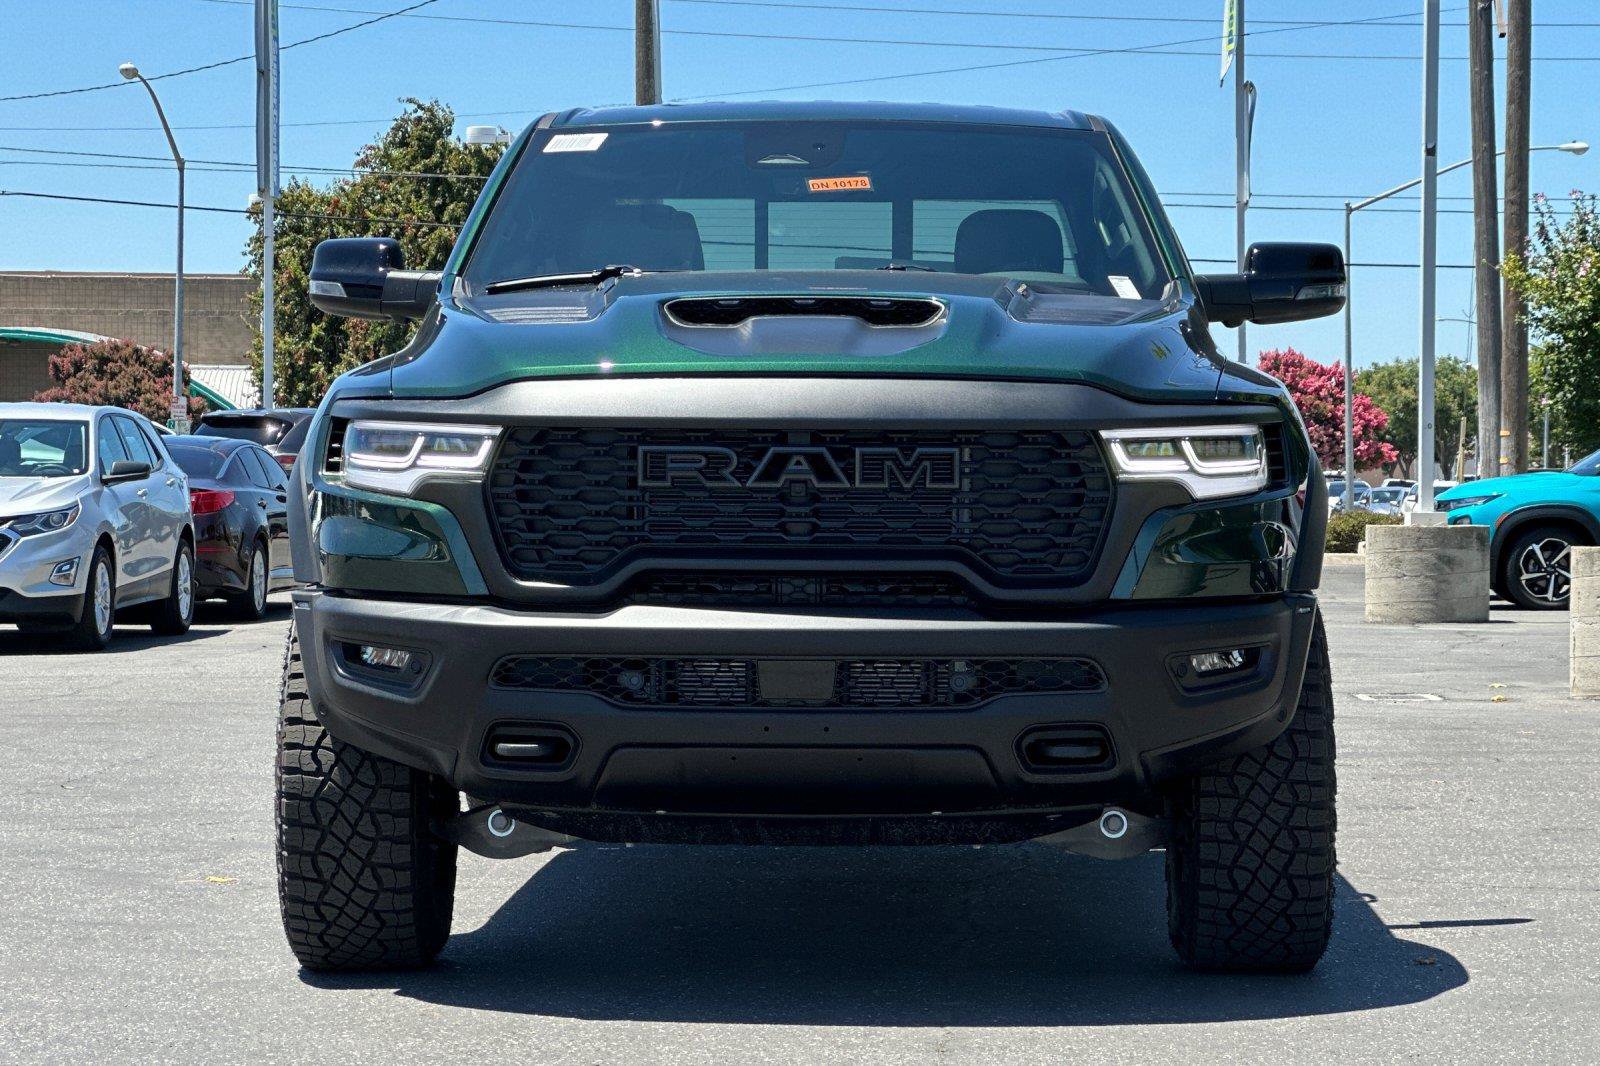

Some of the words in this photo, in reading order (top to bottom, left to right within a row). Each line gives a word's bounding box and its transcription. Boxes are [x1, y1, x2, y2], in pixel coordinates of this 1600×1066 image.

[811, 182, 829, 190] DN
[833, 179, 868, 188] 10178
[637, 446, 961, 489] RAM
